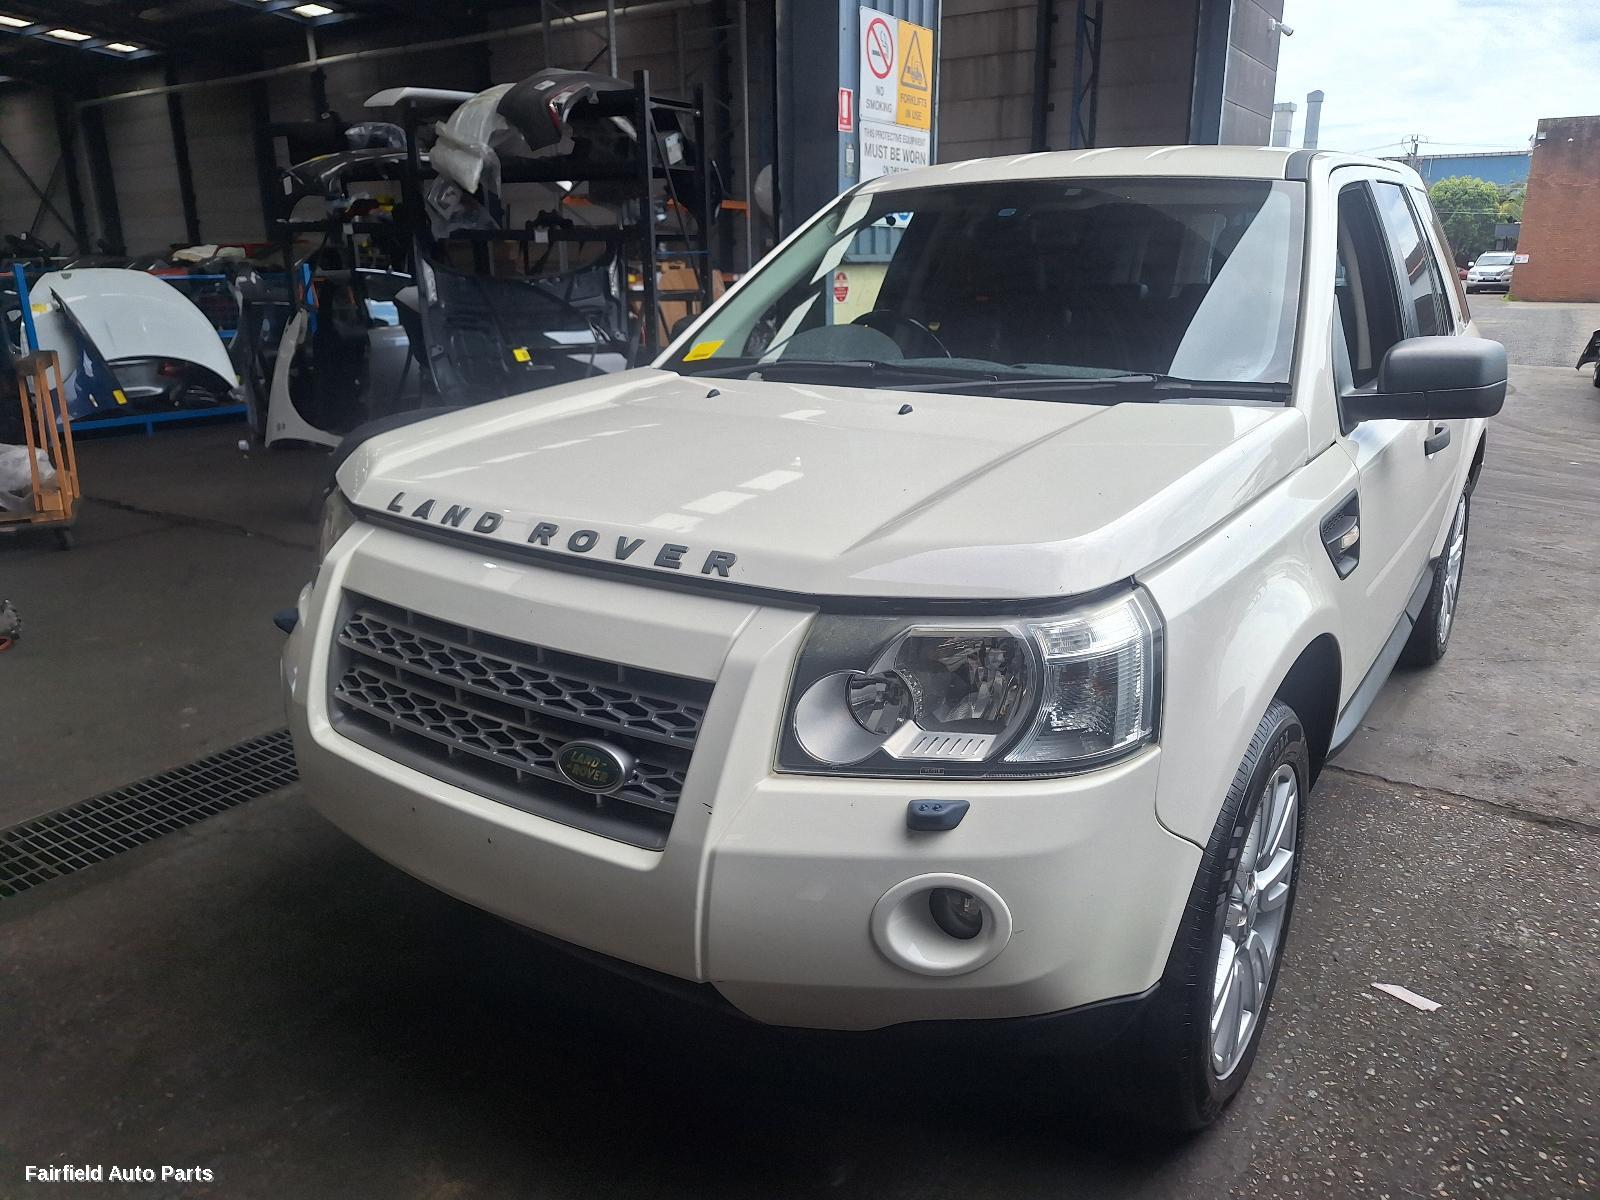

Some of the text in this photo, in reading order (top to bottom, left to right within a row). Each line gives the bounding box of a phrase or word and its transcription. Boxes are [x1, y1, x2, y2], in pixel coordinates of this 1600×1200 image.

[875, 85, 885, 97] NO
[865, 98, 893, 113] SMOKING
[900, 92, 927, 108] FORKLIFTS
[912, 110, 922, 121] USE
[864, 142, 926, 165] MUST BE WORN
[387, 491, 737, 578] LAND ROVER
